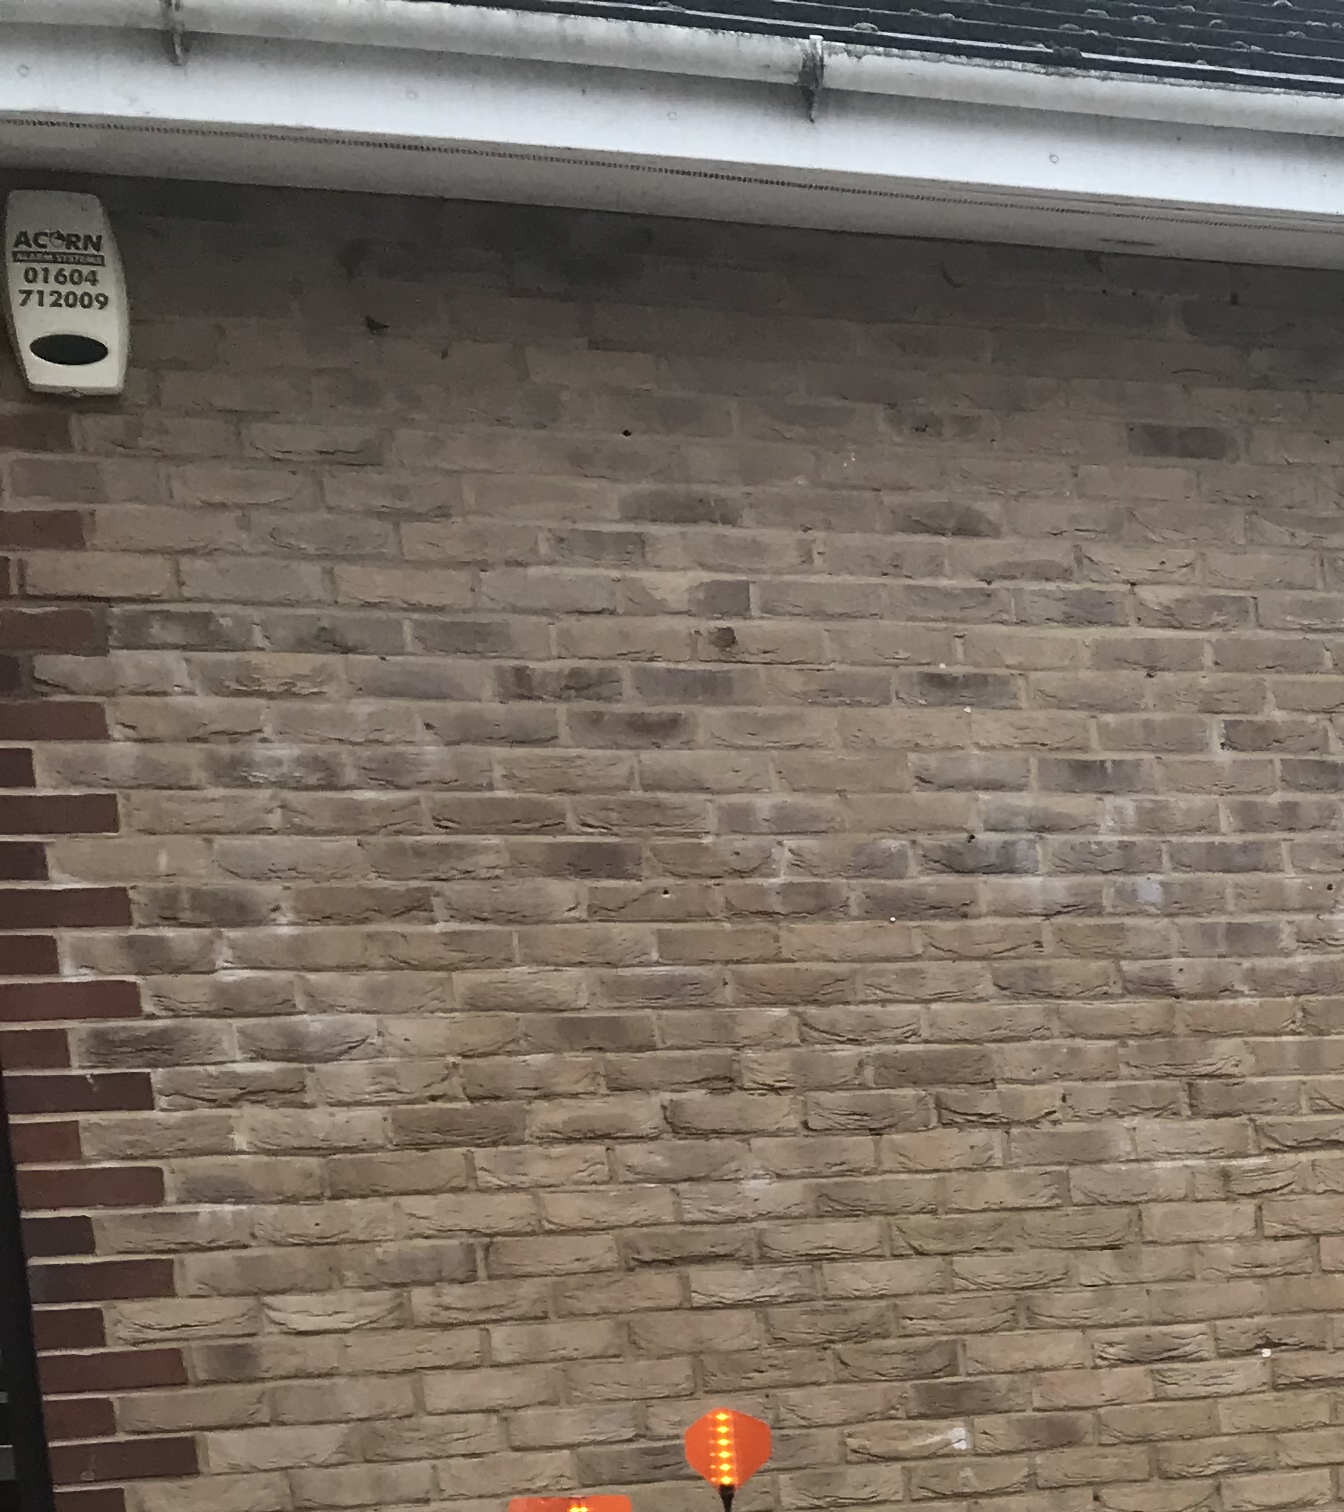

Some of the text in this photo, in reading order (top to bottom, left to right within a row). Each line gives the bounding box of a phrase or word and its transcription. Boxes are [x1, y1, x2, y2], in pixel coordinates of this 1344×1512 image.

[13, 230, 102, 252] ACORN
[24, 267, 99, 286] 01604
[18, 289, 109, 309] 712009
